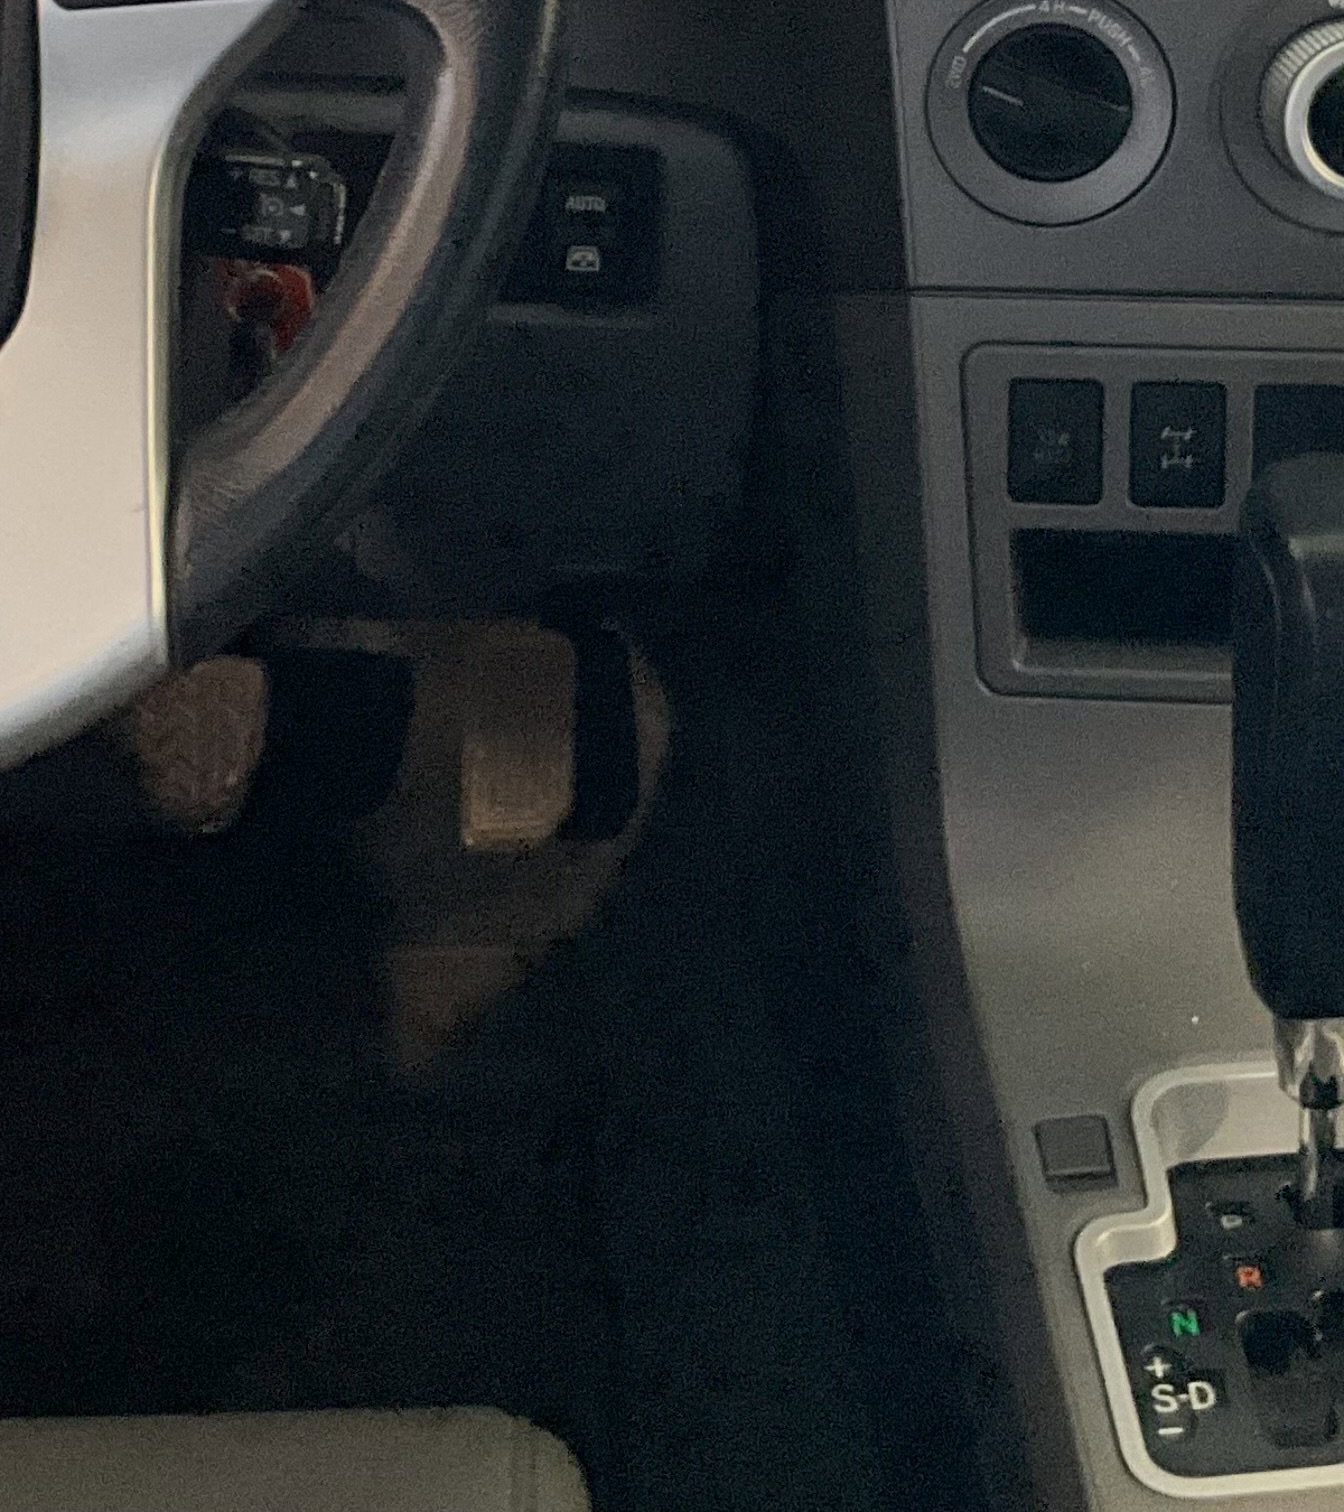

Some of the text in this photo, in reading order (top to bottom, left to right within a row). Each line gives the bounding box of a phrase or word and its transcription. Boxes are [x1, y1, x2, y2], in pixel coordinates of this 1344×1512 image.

[1088, 8, 1132, 47] PUSH
[565, 195, 606, 212] AUTO
[1170, 1310, 1200, 1337] N
